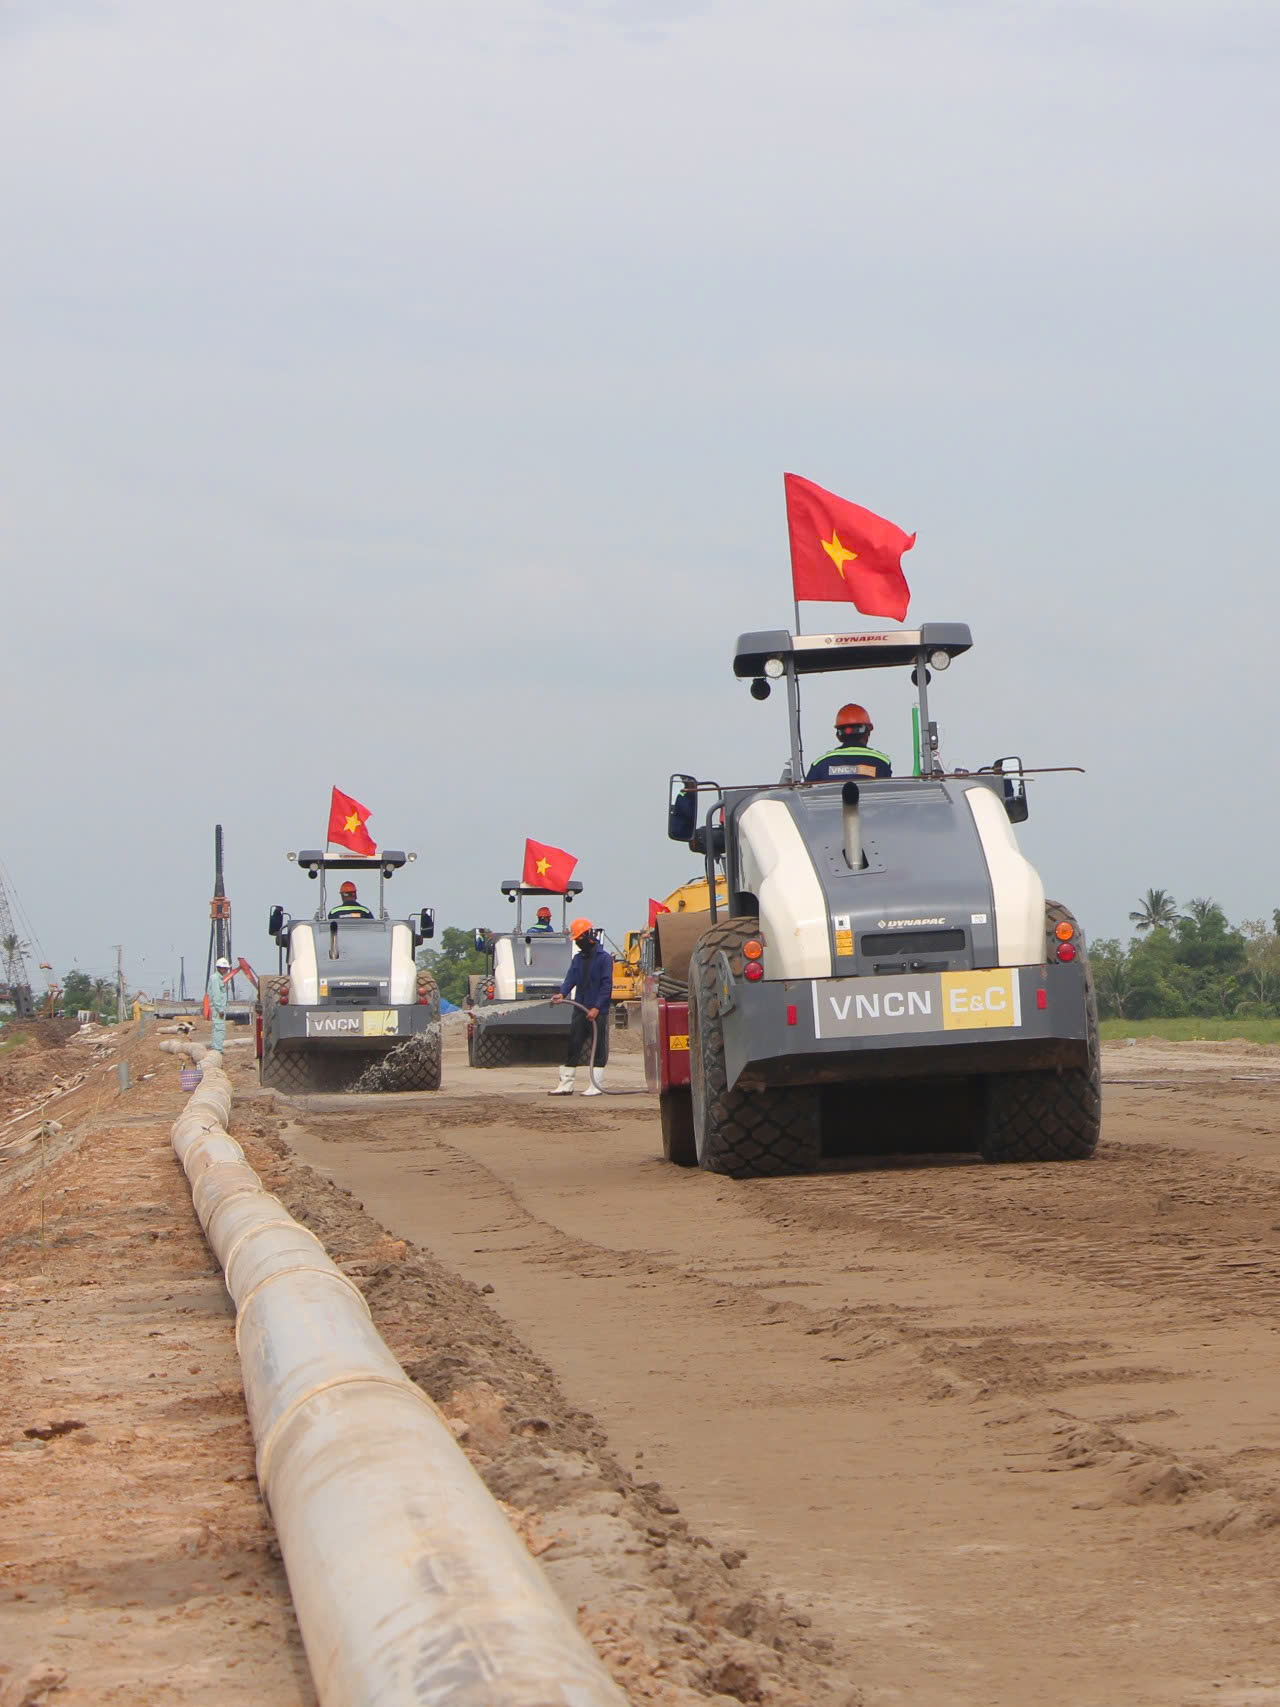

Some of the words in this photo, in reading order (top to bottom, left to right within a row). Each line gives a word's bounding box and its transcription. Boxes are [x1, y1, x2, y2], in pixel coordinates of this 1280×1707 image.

[834, 635, 889, 644] DYNAPAC
[887, 917, 946, 928] DYNAPAC
[829, 990, 932, 1020] VNCN
[950, 986, 1007, 1013] E&C
[314, 1018, 360, 1031] VNCN
